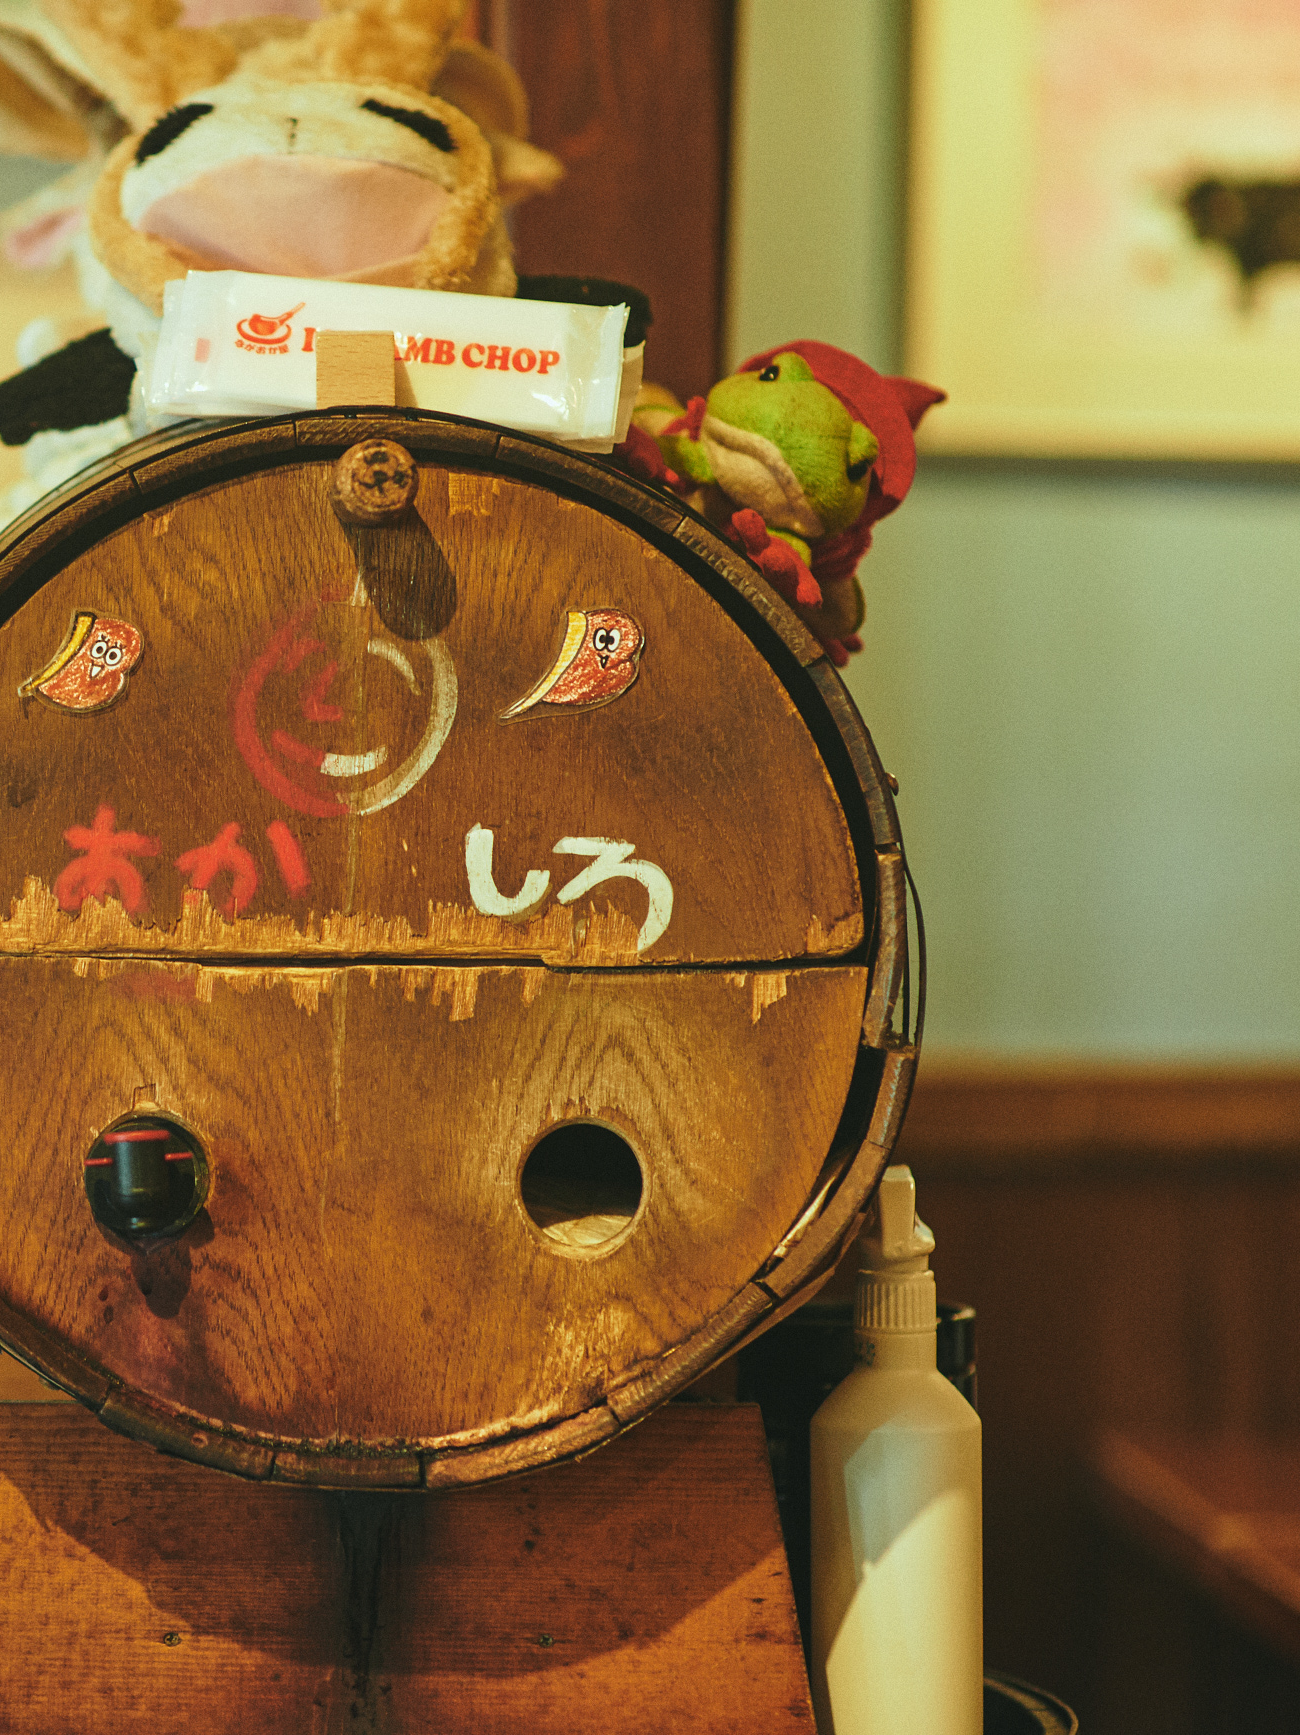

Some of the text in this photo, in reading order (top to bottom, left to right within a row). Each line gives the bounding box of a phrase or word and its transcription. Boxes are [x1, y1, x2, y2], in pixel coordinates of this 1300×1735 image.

[461, 342, 561, 375] CHOP
[54, 803, 312, 918] あか
[465, 821, 674, 955] しろ
